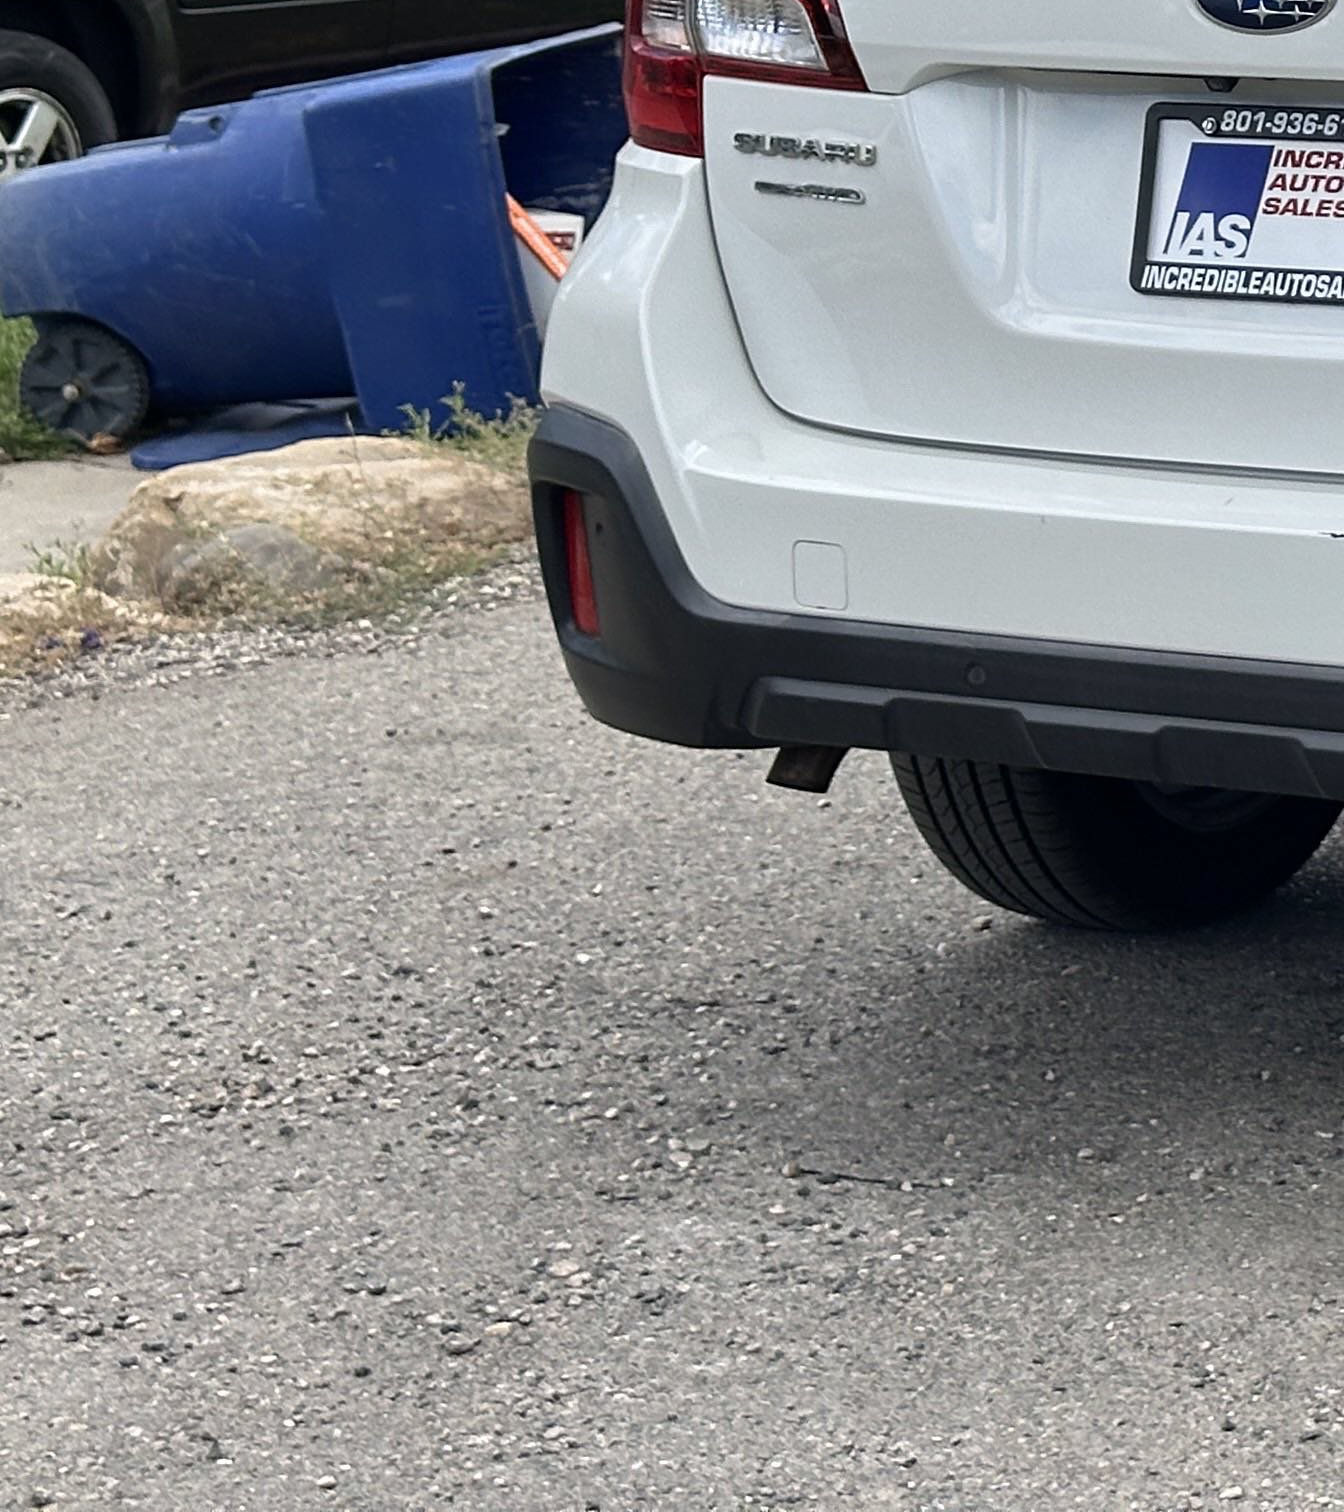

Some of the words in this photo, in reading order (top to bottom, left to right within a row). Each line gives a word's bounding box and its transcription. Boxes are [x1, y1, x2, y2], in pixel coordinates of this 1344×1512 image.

[734, 133, 877, 166] SUBARU
[1268, 174, 1344, 194] AUTO
[1167, 211, 1251, 258] IAS
